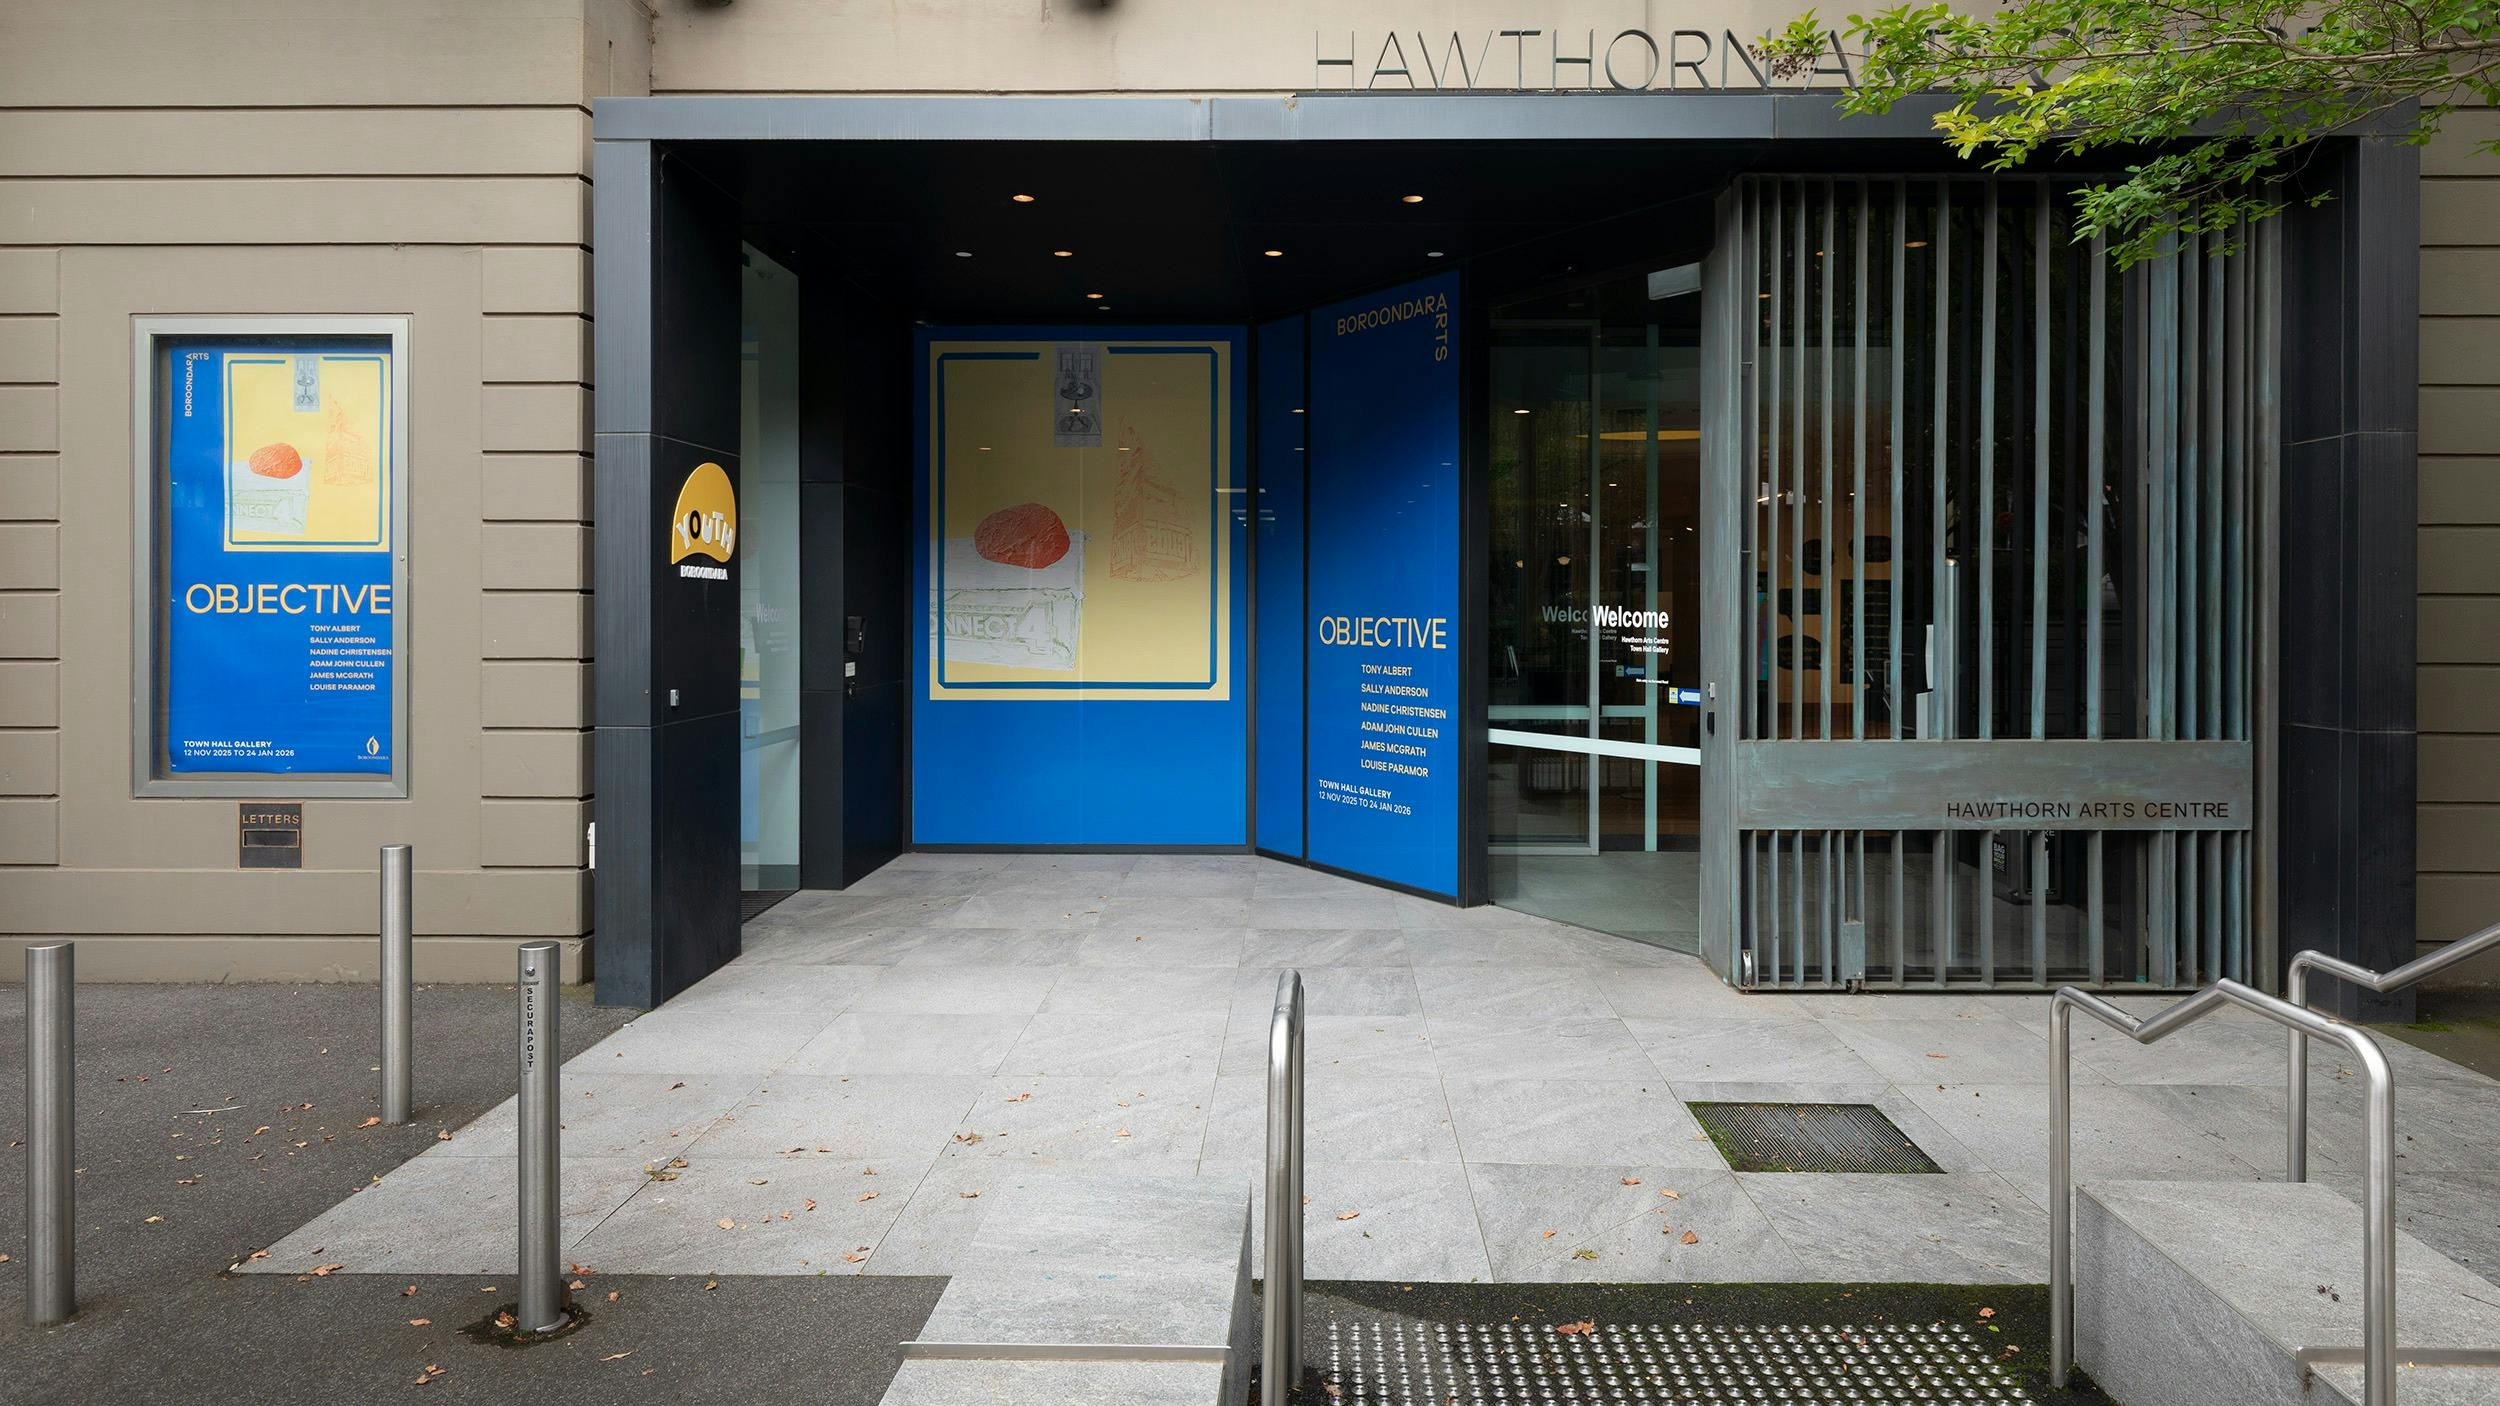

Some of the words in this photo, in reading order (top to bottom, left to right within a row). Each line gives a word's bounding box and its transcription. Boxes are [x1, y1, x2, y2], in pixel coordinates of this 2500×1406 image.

[1315, 28, 1772, 92] HAWTHORN
[1337, 292, 1448, 336] BOROONDARA
[185, 352, 193, 417] BOROONDARA
[676, 509, 734, 555] YOUTH
[185, 583, 392, 614] OBJECTIVE
[1592, 605, 1669, 629] Welcome
[1319, 616, 1447, 649] OBJECTIVE
[1630, 645, 1642, 653] Town
[1652, 646, 1669, 655] Gallery
[1361, 664, 1382, 674] TONY
[1382, 666, 1413, 677] ALBERT
[1361, 683, 1384, 694] SALLY
[1384, 685, 1429, 697] ANDERSON
[1361, 702, 1390, 714] NADINE
[1390, 705, 1447, 719] CHRISTENSEN
[1361, 721, 1384, 732] ADAM
[1384, 723, 1406, 735] JOHN
[1406, 726, 1439, 739] CULLEN
[184, 740, 210, 748] TOWN
[1361, 740, 1386, 752] JAMES
[1386, 743, 1427, 757] MCGRATH
[1361, 758, 1388, 772] LOUISE
[1388, 762, 1429, 778] PARAMOR
[1319, 779, 1340, 790] TOWN
[1340, 783, 1358, 794] HALL
[1359, 786, 1392, 799] GALLERY
[1319, 790, 1326, 799] 12
[1326, 792, 1341, 802] NOV
[1342, 794, 1358, 805] 2025
[1358, 798, 1369, 808] TO
[1369, 800, 1378, 809] 24
[1378, 802, 1393, 812] JAN
[1393, 804, 1411, 815] 2026
[1947, 802, 2071, 818] HAWTHORN
[2079, 802, 2136, 818] ARTS
[2144, 802, 2229, 818] CENTRE
[242, 814, 300, 824] LETTERS
[526, 987, 535, 1068] SECURAPOST
